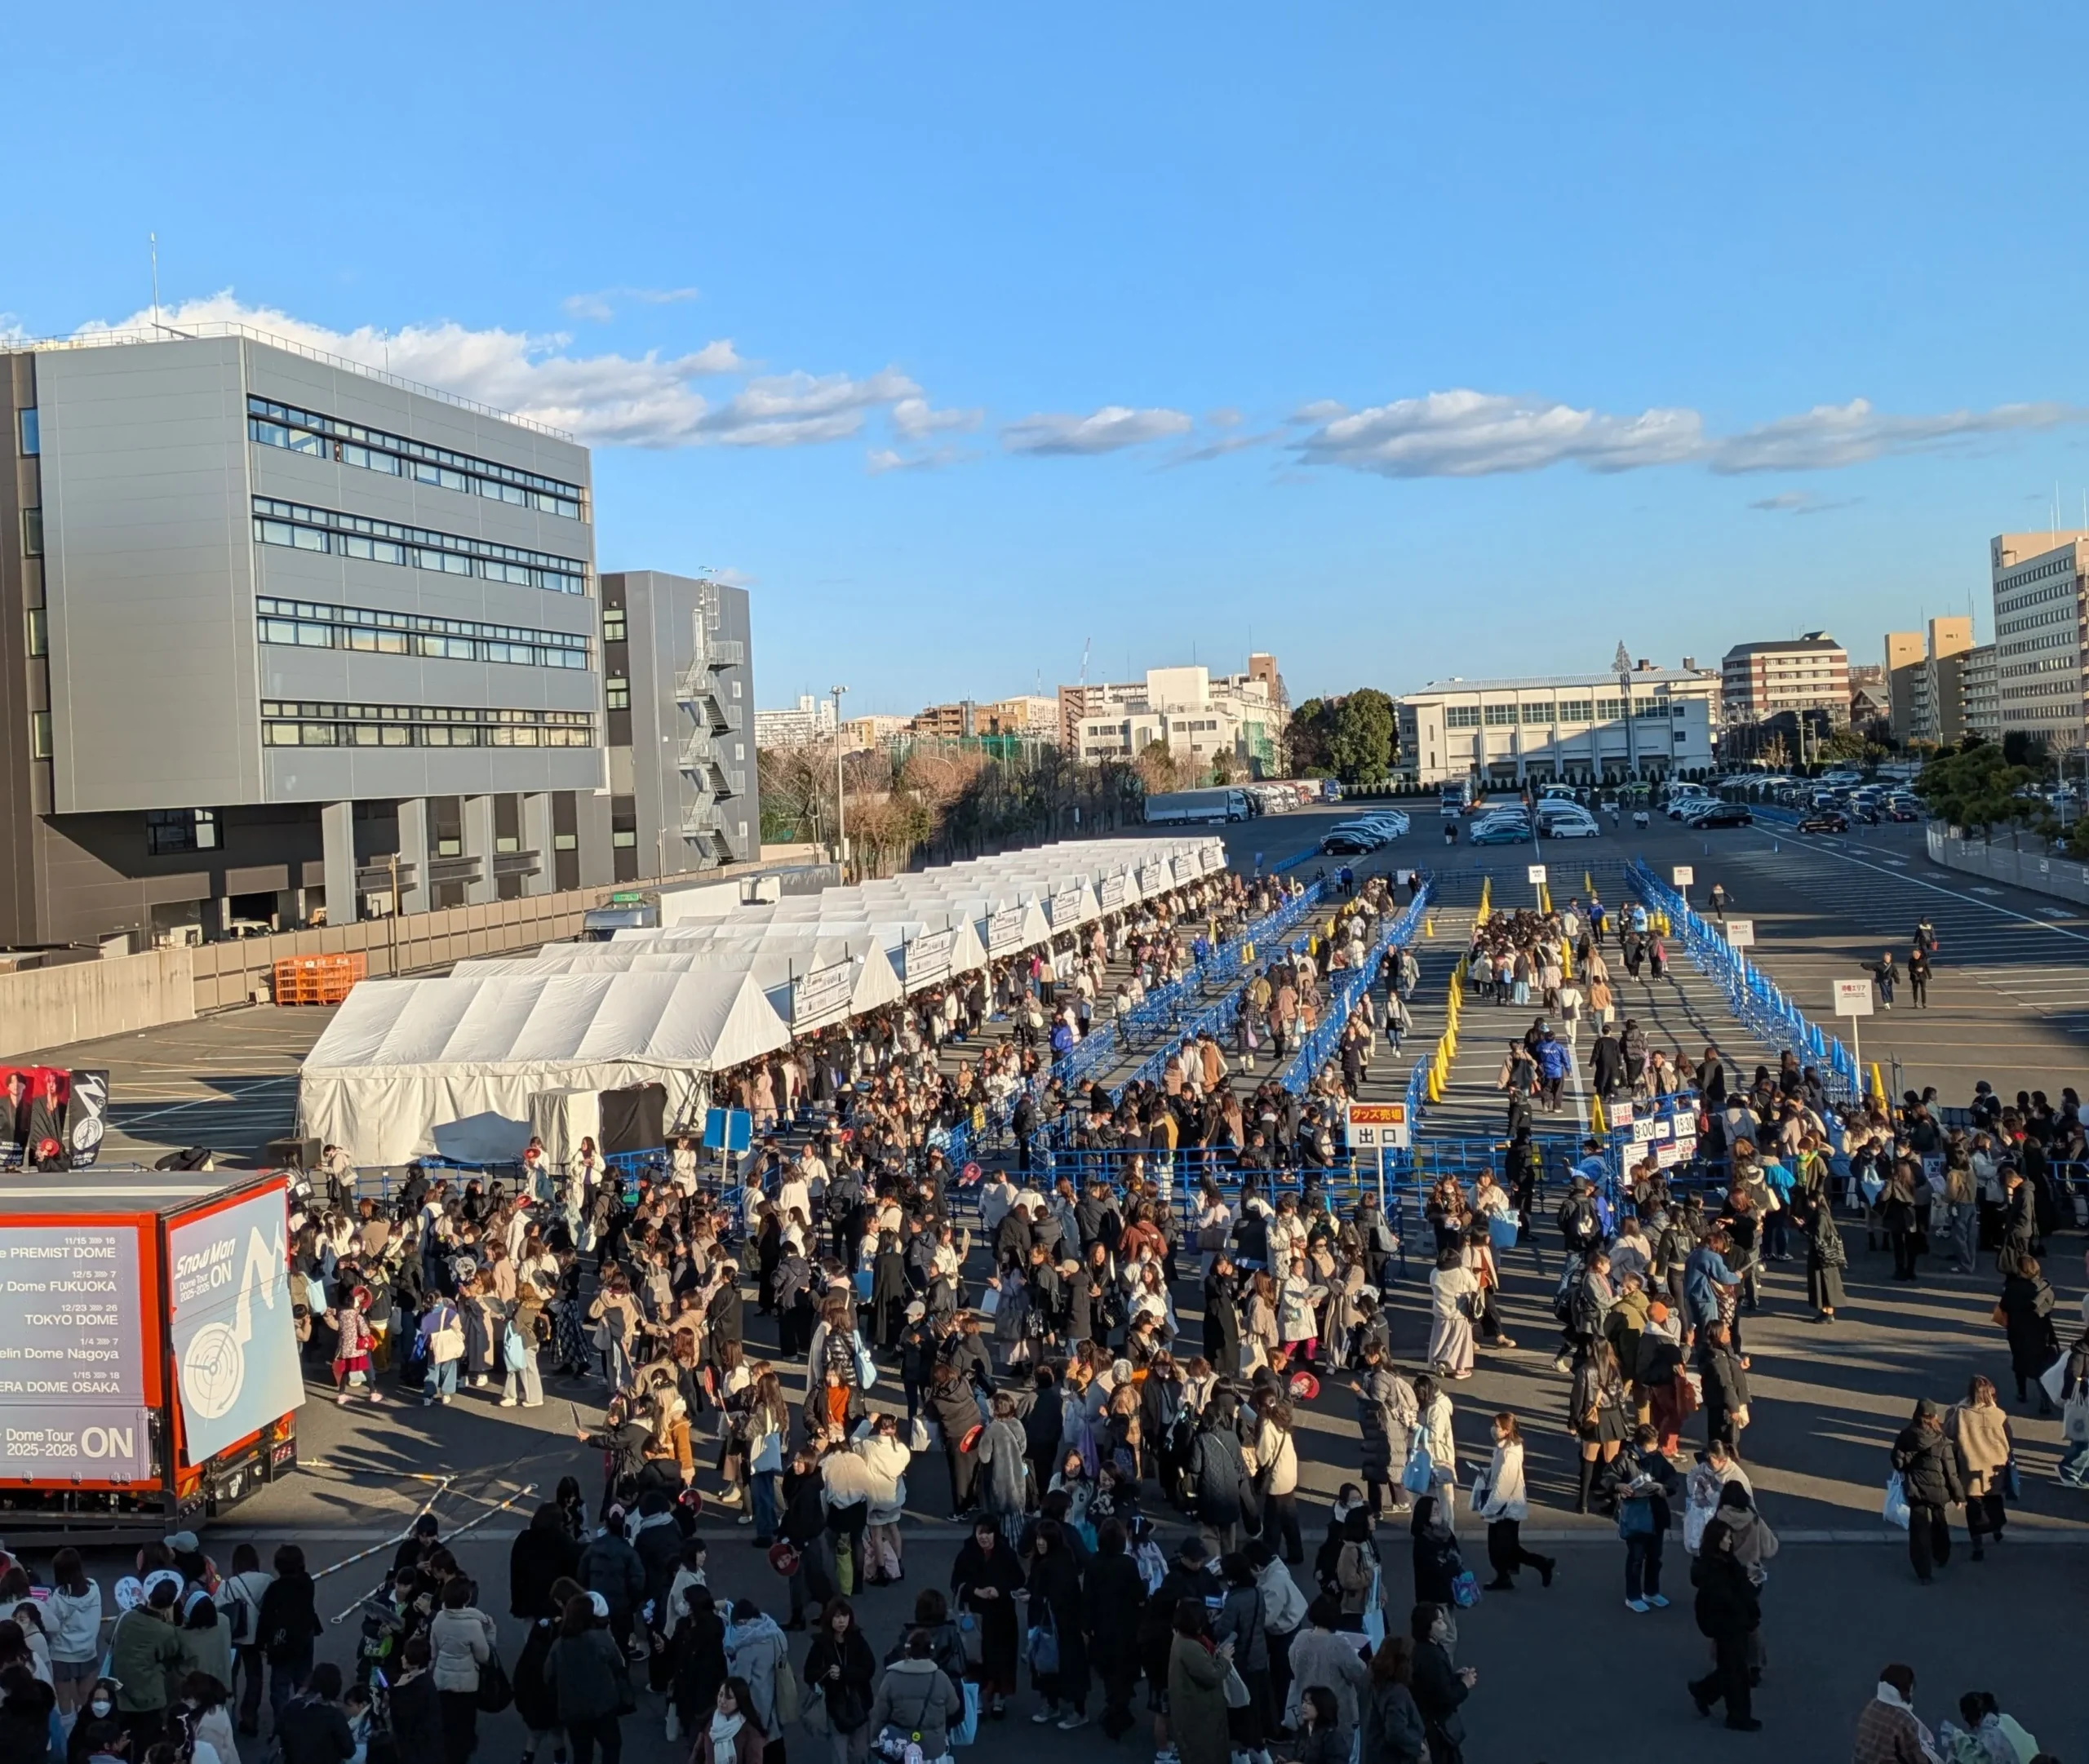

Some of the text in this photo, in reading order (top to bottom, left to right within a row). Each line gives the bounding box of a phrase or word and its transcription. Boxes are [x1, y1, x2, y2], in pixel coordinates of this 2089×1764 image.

[1351, 1108, 1402, 1120] グッズ売場
[1634, 1121, 1654, 1139] 9:00
[1676, 1116, 1695, 1133] 15:30
[1359, 1128, 1396, 1144] 出口
[11, 1248, 70, 1258] PREMIST
[73, 1248, 116, 1258] DOME
[174, 1238, 236, 1279] Snow Man
[72, 1270, 92, 1279] 12/5
[211, 1259, 232, 1288] ON
[7, 1281, 46, 1292] Dome
[50, 1281, 117, 1292] FUKUOKA
[180, 1273, 209, 1292] Dome Tour
[24, 1314, 118, 1325] TOKYO DOME
[0, 1348, 120, 1362] elin Dome Nagoya
[109, 1372, 120, 1380] 18
[0, 1381, 120, 1394] ERA DOME OSAKA
[6, 1428, 74, 1442] Dome Tour
[81, 1426, 134, 1458] ON
[7, 1443, 78, 1457] 2025-2026
